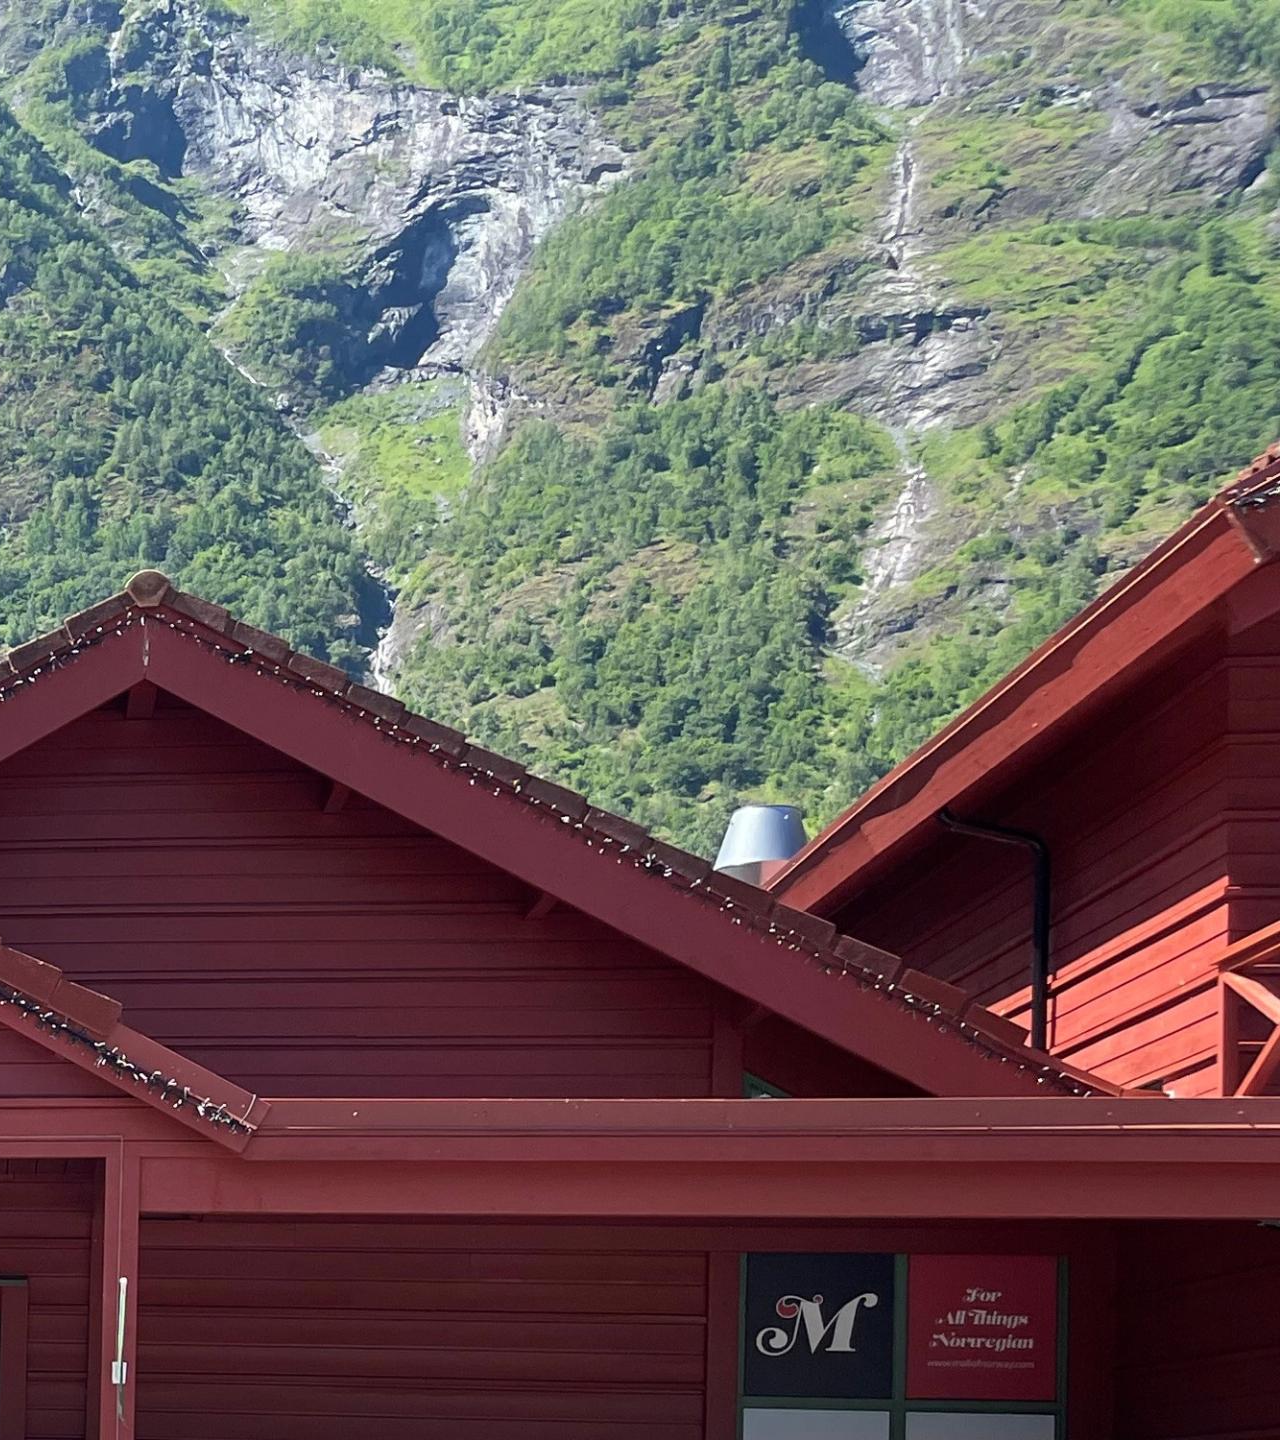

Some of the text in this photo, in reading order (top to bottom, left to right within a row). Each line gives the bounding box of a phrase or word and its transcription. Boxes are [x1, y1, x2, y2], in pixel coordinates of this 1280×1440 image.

[962, 1287, 1002, 1302] For
[755, 1293, 878, 1356] M
[935, 1308, 1029, 1329] All Things
[929, 1332, 1034, 1351] Norwegian
